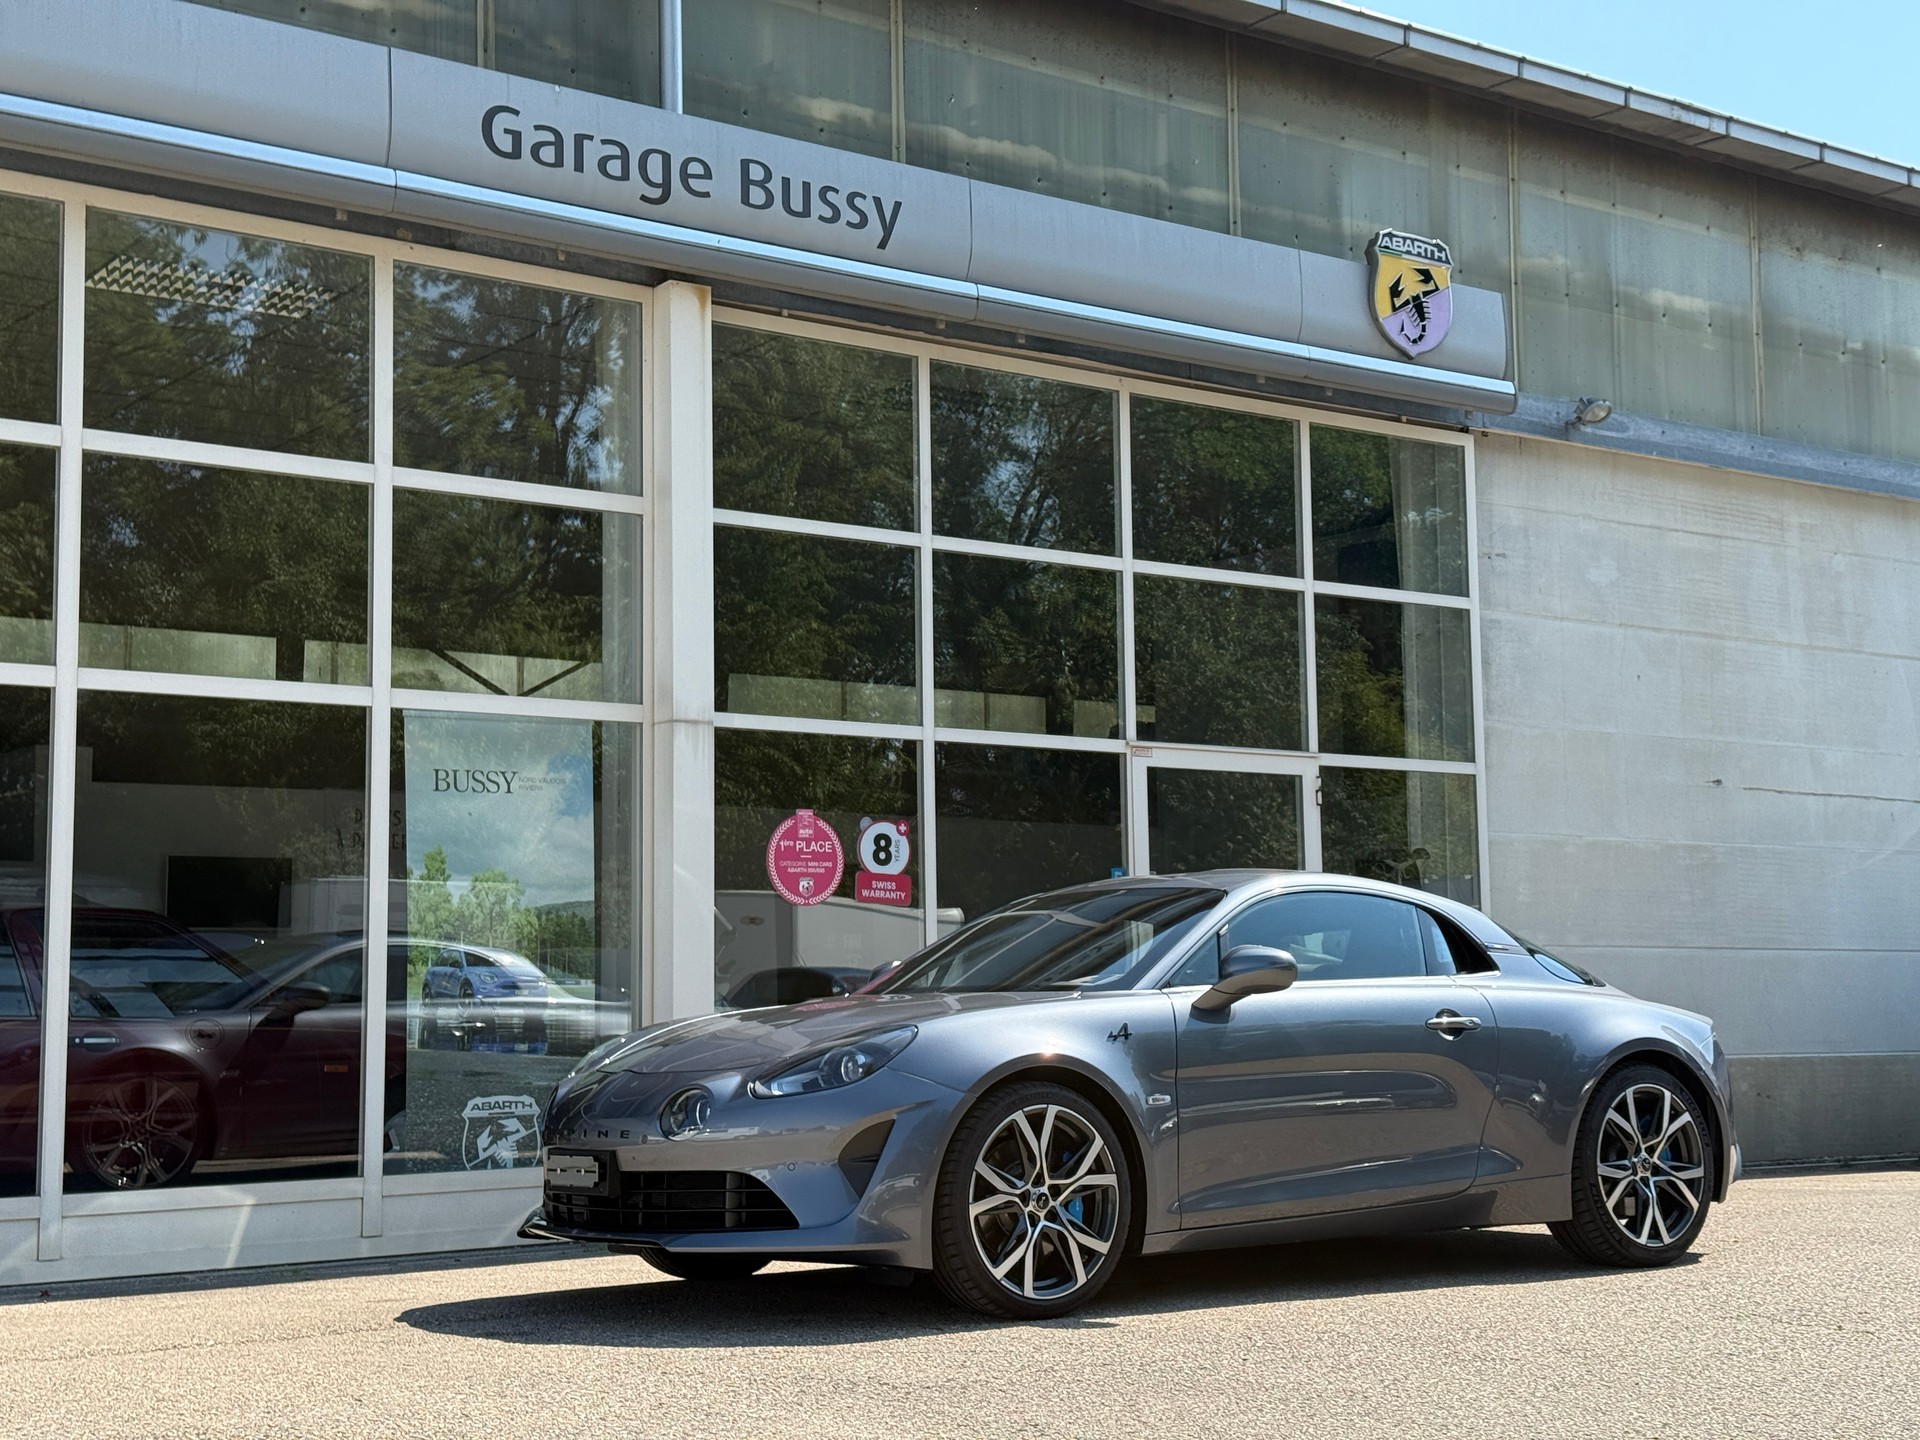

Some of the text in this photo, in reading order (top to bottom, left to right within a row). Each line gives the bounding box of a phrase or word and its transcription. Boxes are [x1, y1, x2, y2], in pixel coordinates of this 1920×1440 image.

[481, 105, 903, 250] Garage Bussy
[1381, 237, 1446, 261] ABARTH
[433, 768, 518, 794] BUSSY
[796, 840, 833, 852] PLACE
[872, 833, 893, 866] 8
[872, 880, 897, 890] SWISS
[862, 889, 906, 900] WARRANTY
[470, 1100, 533, 1111] ABARTH
